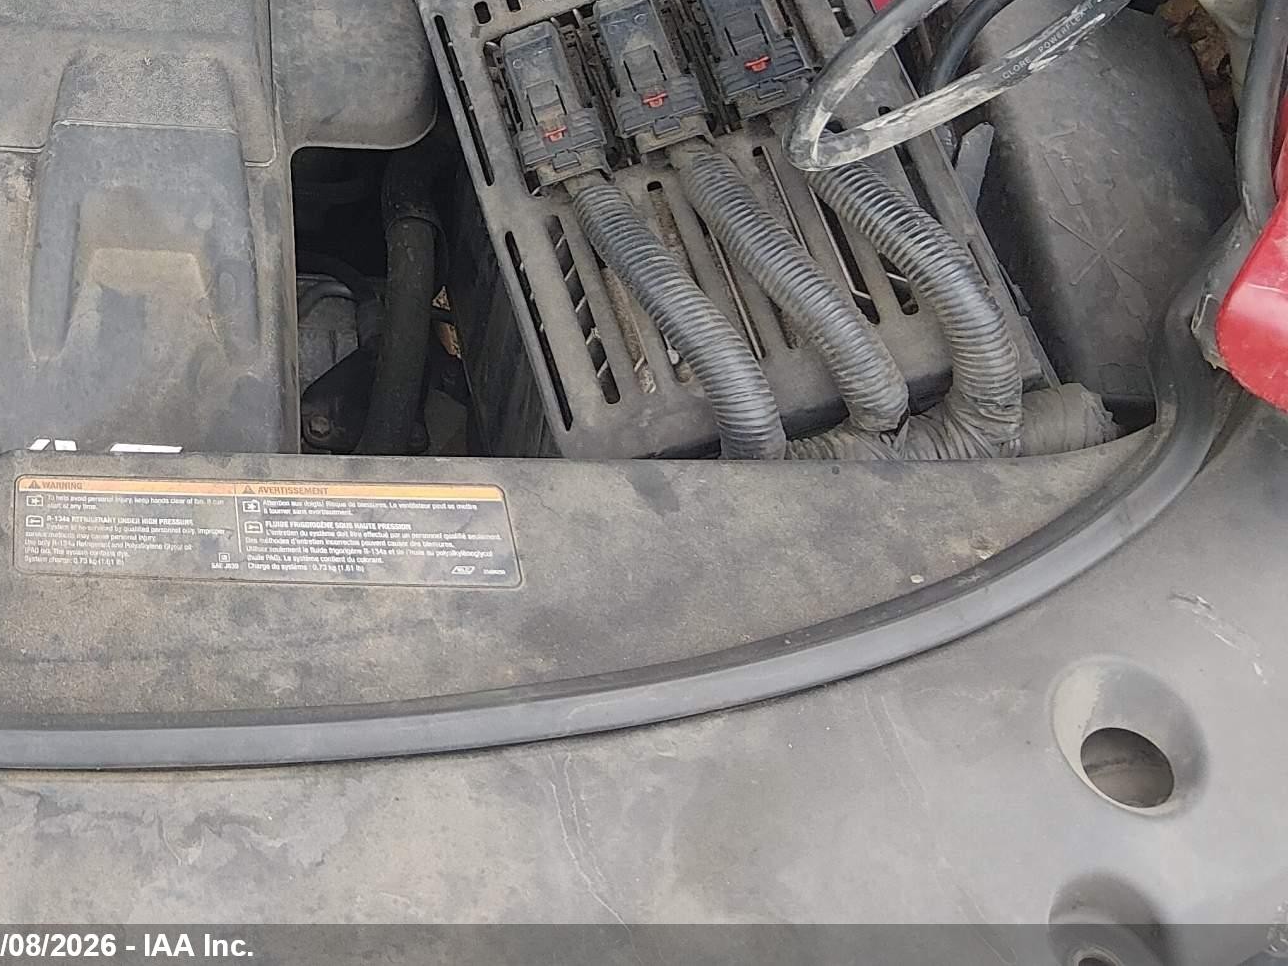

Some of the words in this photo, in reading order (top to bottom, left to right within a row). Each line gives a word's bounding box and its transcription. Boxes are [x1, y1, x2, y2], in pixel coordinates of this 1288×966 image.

[1002, 56, 1031, 80] CLORE
[42, 481, 83, 490] WARNING
[258, 486, 329, 495] AVERTISSEMENT
